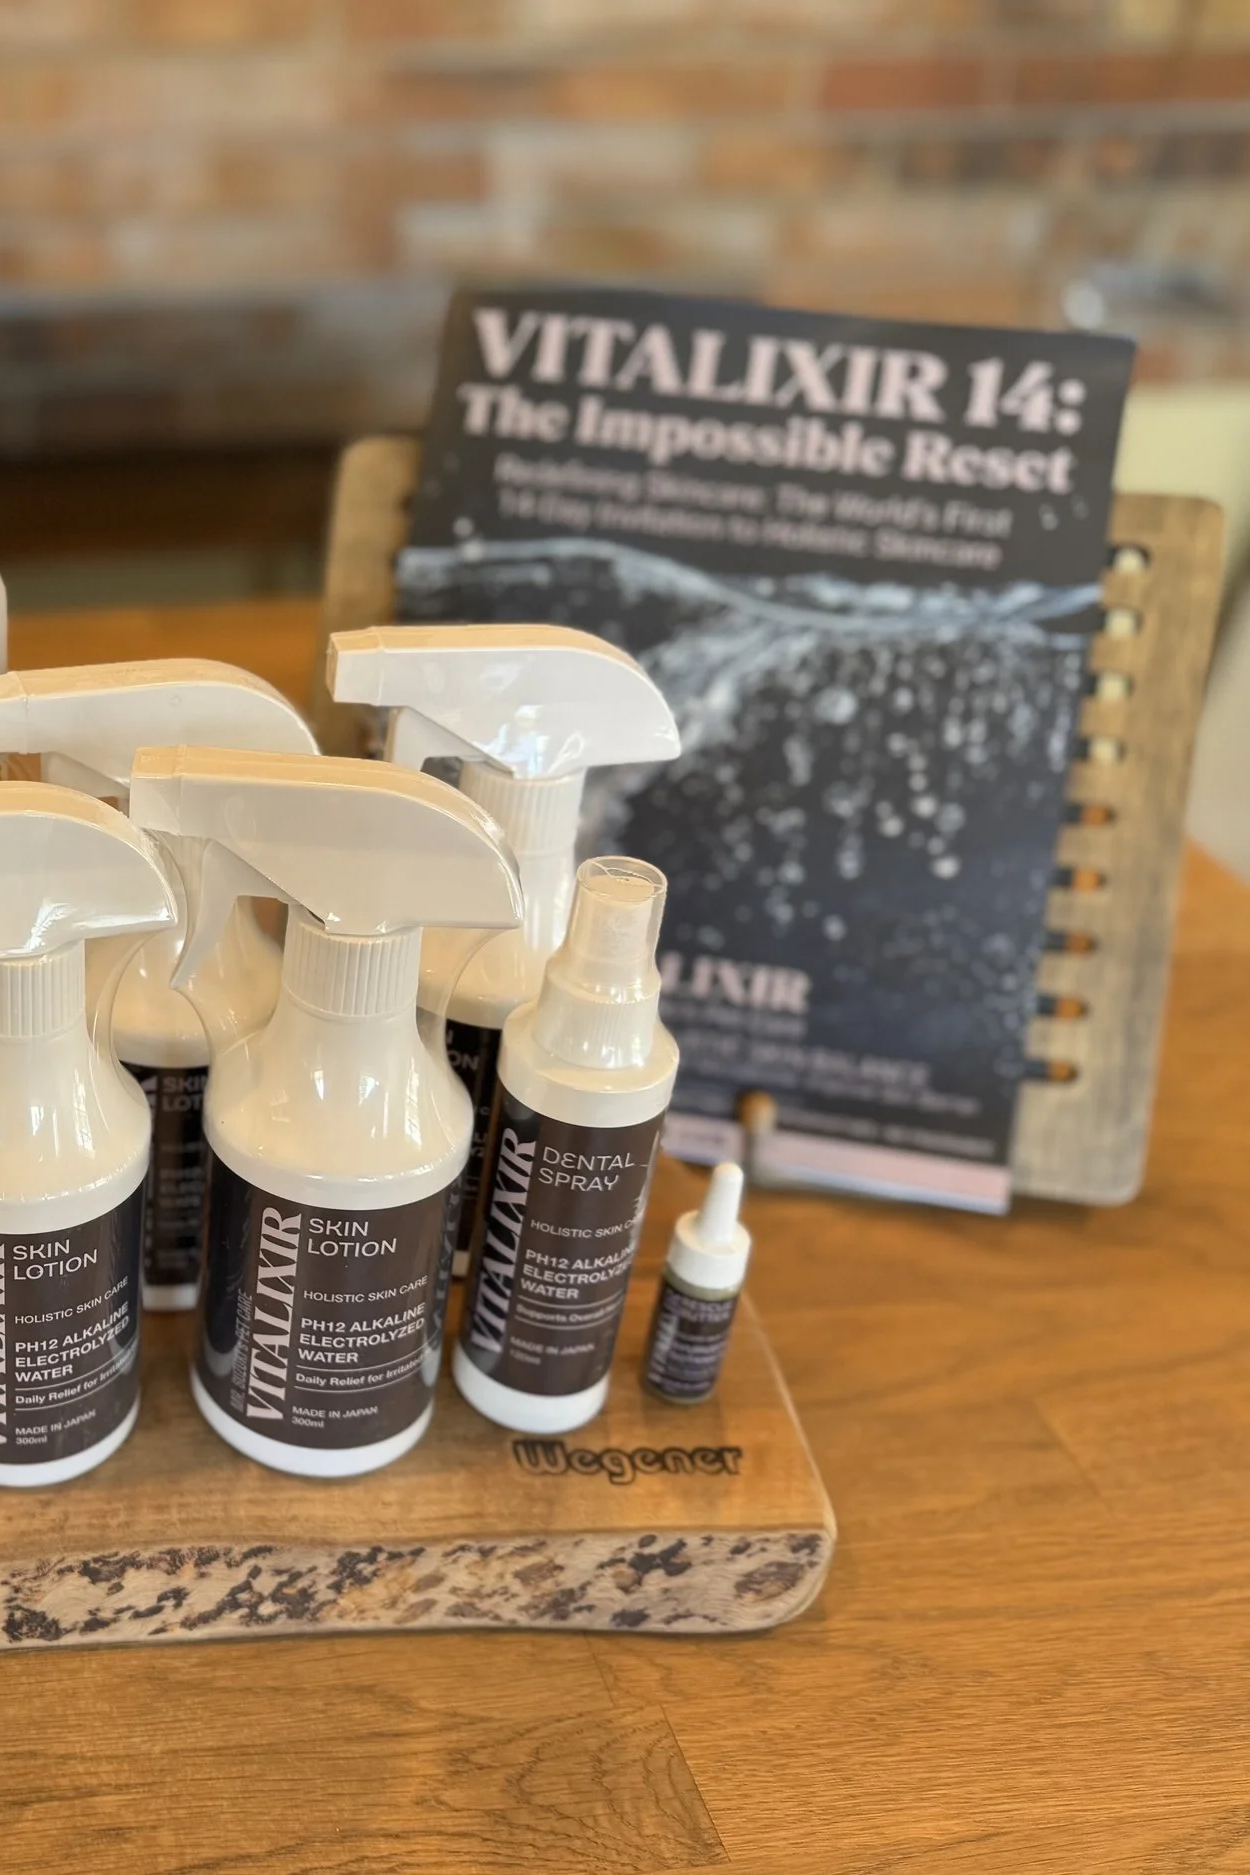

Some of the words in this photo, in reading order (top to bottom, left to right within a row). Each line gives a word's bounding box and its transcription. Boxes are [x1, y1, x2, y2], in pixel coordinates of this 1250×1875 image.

[472, 307, 946, 424] VITALIXIR
[964, 356, 1086, 437] 14:
[456, 381, 569, 443] The
[574, 395, 896, 478] Impossible
[903, 428, 1077, 495] Reset
[775, 482, 829, 515] The
[943, 502, 1013, 539] First
[658, 950, 814, 1014] LIXIR
[162, 1076, 207, 1093] SKI
[543, 1146, 634, 1171] DENTAL
[538, 1168, 619, 1191] SPRAY
[309, 1218, 369, 1236] SKIN
[530, 1219, 592, 1238] HOLISTIC
[595, 1223, 623, 1238] SKIN
[13, 1239, 70, 1260] SKIN
[307, 1238, 397, 1257] LOTION
[470, 1127, 537, 1354] VITALIXIR
[14, 1249, 97, 1280] LOTION
[526, 1249, 570, 1269] PH12
[572, 1247, 631, 1270] ALKALIN
[15, 1308, 73, 1324] HOLISTIC
[76, 1295, 102, 1314] SKIN
[104, 1276, 129, 1300] CARE
[303, 1290, 365, 1303] HOLISTIC
[367, 1288, 397, 1302] SKIN
[399, 1275, 428, 1295] CARE
[521, 1278, 579, 1299] WATER
[237, 1288, 253, 1321] CARE
[246, 1206, 302, 1420] VITALIXIR
[301, 1317, 346, 1333] PH12
[350, 1302, 425, 1332] ALKALINE
[15, 1339, 59, 1352] PH12
[62, 1300, 129, 1346] ALKALINE
[235, 1317, 250, 1342] PET
[299, 1317, 425, 1348] ELECTROLYZED
[15, 1315, 130, 1367] ELECTROLYZED
[510, 1336, 543, 1353] MADE
[545, 1345, 558, 1355] IN
[560, 1342, 595, 1355] JAPAN
[298, 1348, 359, 1363] WATER
[15, 1364, 74, 1382] WATER
[295, 1373, 327, 1386] Daily
[329, 1375, 365, 1386] Relief
[367, 1372, 384, 1383] for
[15, 1394, 46, 1404] Daily
[48, 1384, 81, 1401] Relief
[83, 1376, 99, 1390] for
[15, 1425, 48, 1436] MADE
[51, 1422, 62, 1431] IN
[64, 1408, 96, 1428] JAPAN
[292, 1406, 326, 1418] MADE
[328, 1410, 340, 1418] IN
[342, 1405, 379, 1418] JAPAN
[292, 1416, 324, 1428] 300ml
[16, 1435, 47, 1445] 300ml
[512, 1439, 743, 1485] Wegener
